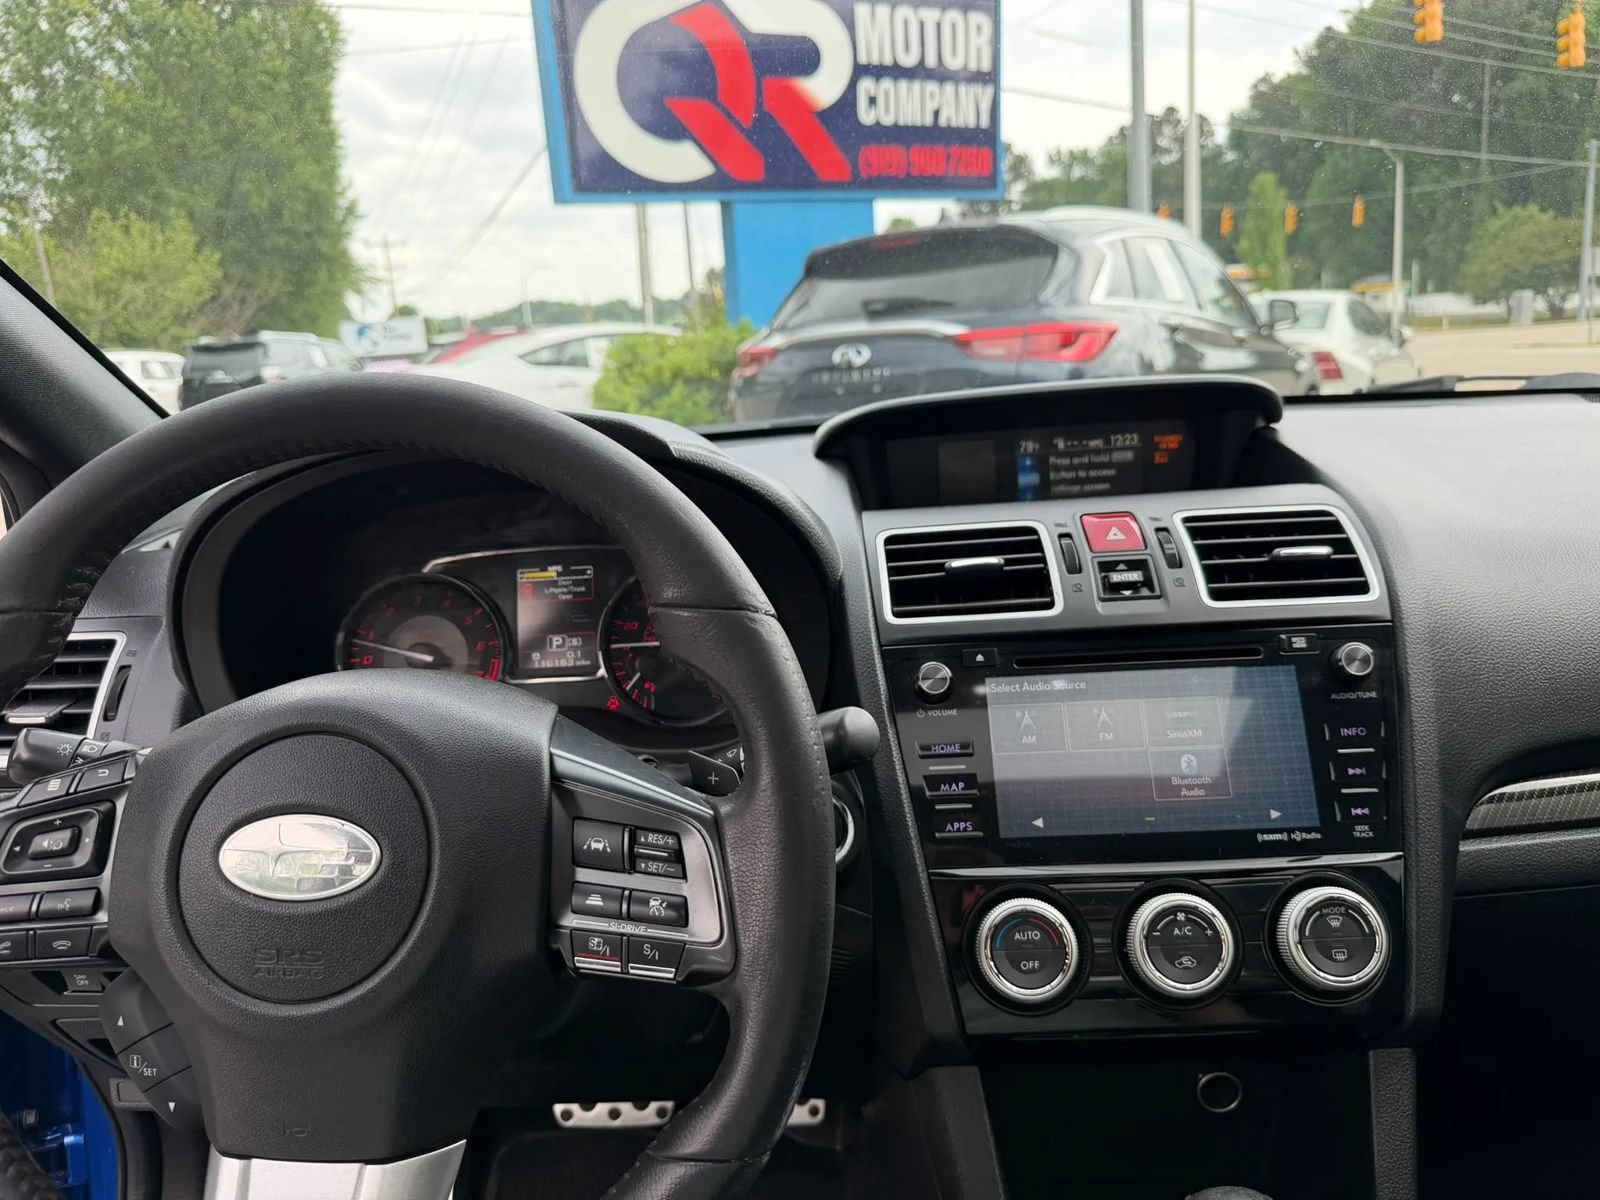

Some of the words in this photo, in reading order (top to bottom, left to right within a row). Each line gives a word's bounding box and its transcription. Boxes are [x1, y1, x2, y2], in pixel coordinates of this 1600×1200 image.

[853, 1, 993, 73] MOTOR
[856, 76, 995, 129] COMPANY
[1111, 573, 1139, 582] ENTER
[552, 637, 563, 649] P
[990, 683, 1020, 693] Select
[1022, 681, 1051, 691] Audio
[1052, 679, 1087, 690] Source
[1331, 691, 1377, 699] AUDIO/TUNE
[1166, 729, 1202, 738] SiriusXM
[1341, 727, 1367, 736] INFO
[1022, 735, 1037, 744] AM
[1099, 732, 1113, 741] FM
[931, 744, 960, 753] HOME
[1171, 776, 1211, 785] Bluetooth
[940, 782, 965, 791] MAP
[1181, 788, 1205, 796] Audio
[945, 822, 972, 832] APPS
[1301, 832, 1321, 840] Radio
[1322, 906, 1346, 914] MODE
[609, 921, 647, 933] SI-DRIVE
[1014, 931, 1041, 941] AUTO
[1173, 927, 1193, 937] A/C
[1020, 961, 1040, 970] OFF
